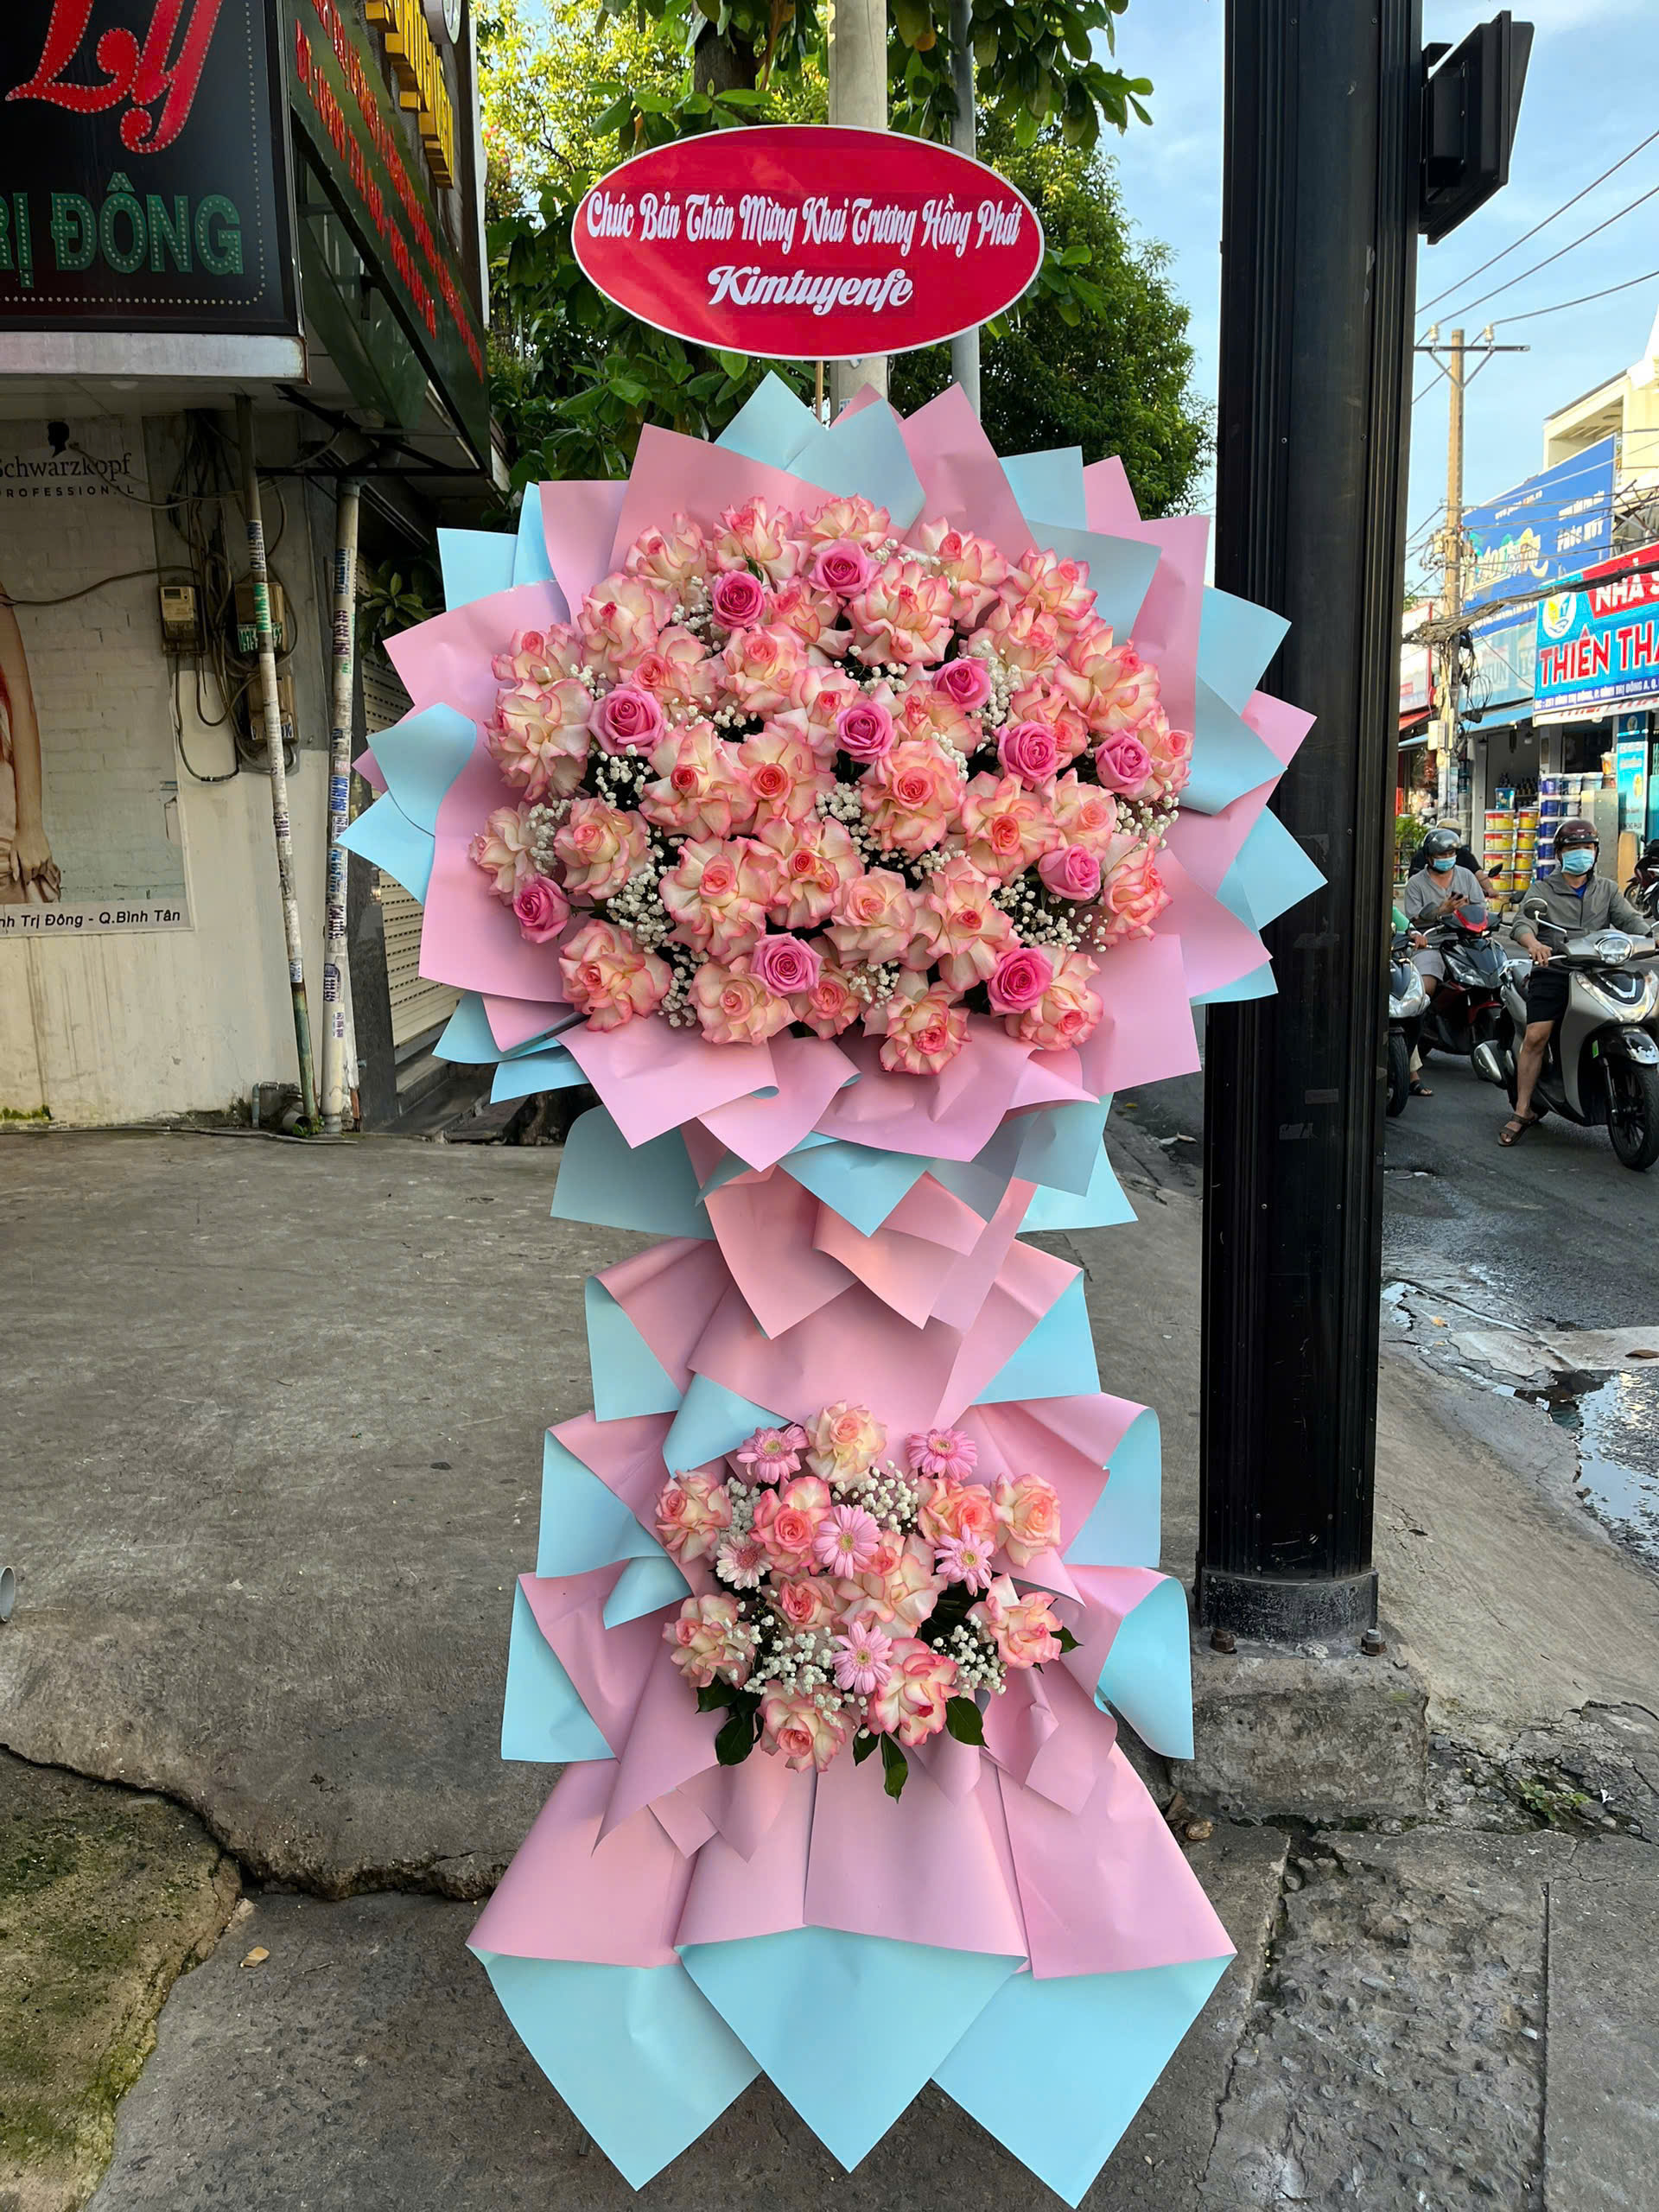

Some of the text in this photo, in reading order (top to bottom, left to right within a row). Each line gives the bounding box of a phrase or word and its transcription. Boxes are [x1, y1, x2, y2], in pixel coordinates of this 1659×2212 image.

[50, 172, 244, 275] ĐÔNG
[588, 191, 1023, 258] Chúc Bản Thân Mừng Khai Trương Hồng Phát
[707, 265, 913, 316] Kimtuyenfe
[0, 486, 134, 499] ROFESSIONL
[1538, 622, 1611, 688] THIÊN
[21, 914, 41, 929] Trị
[45, 913, 84, 929] Đông
[99, 911, 148, 925] Q.Bình
[154, 910, 181, 922] Tân
